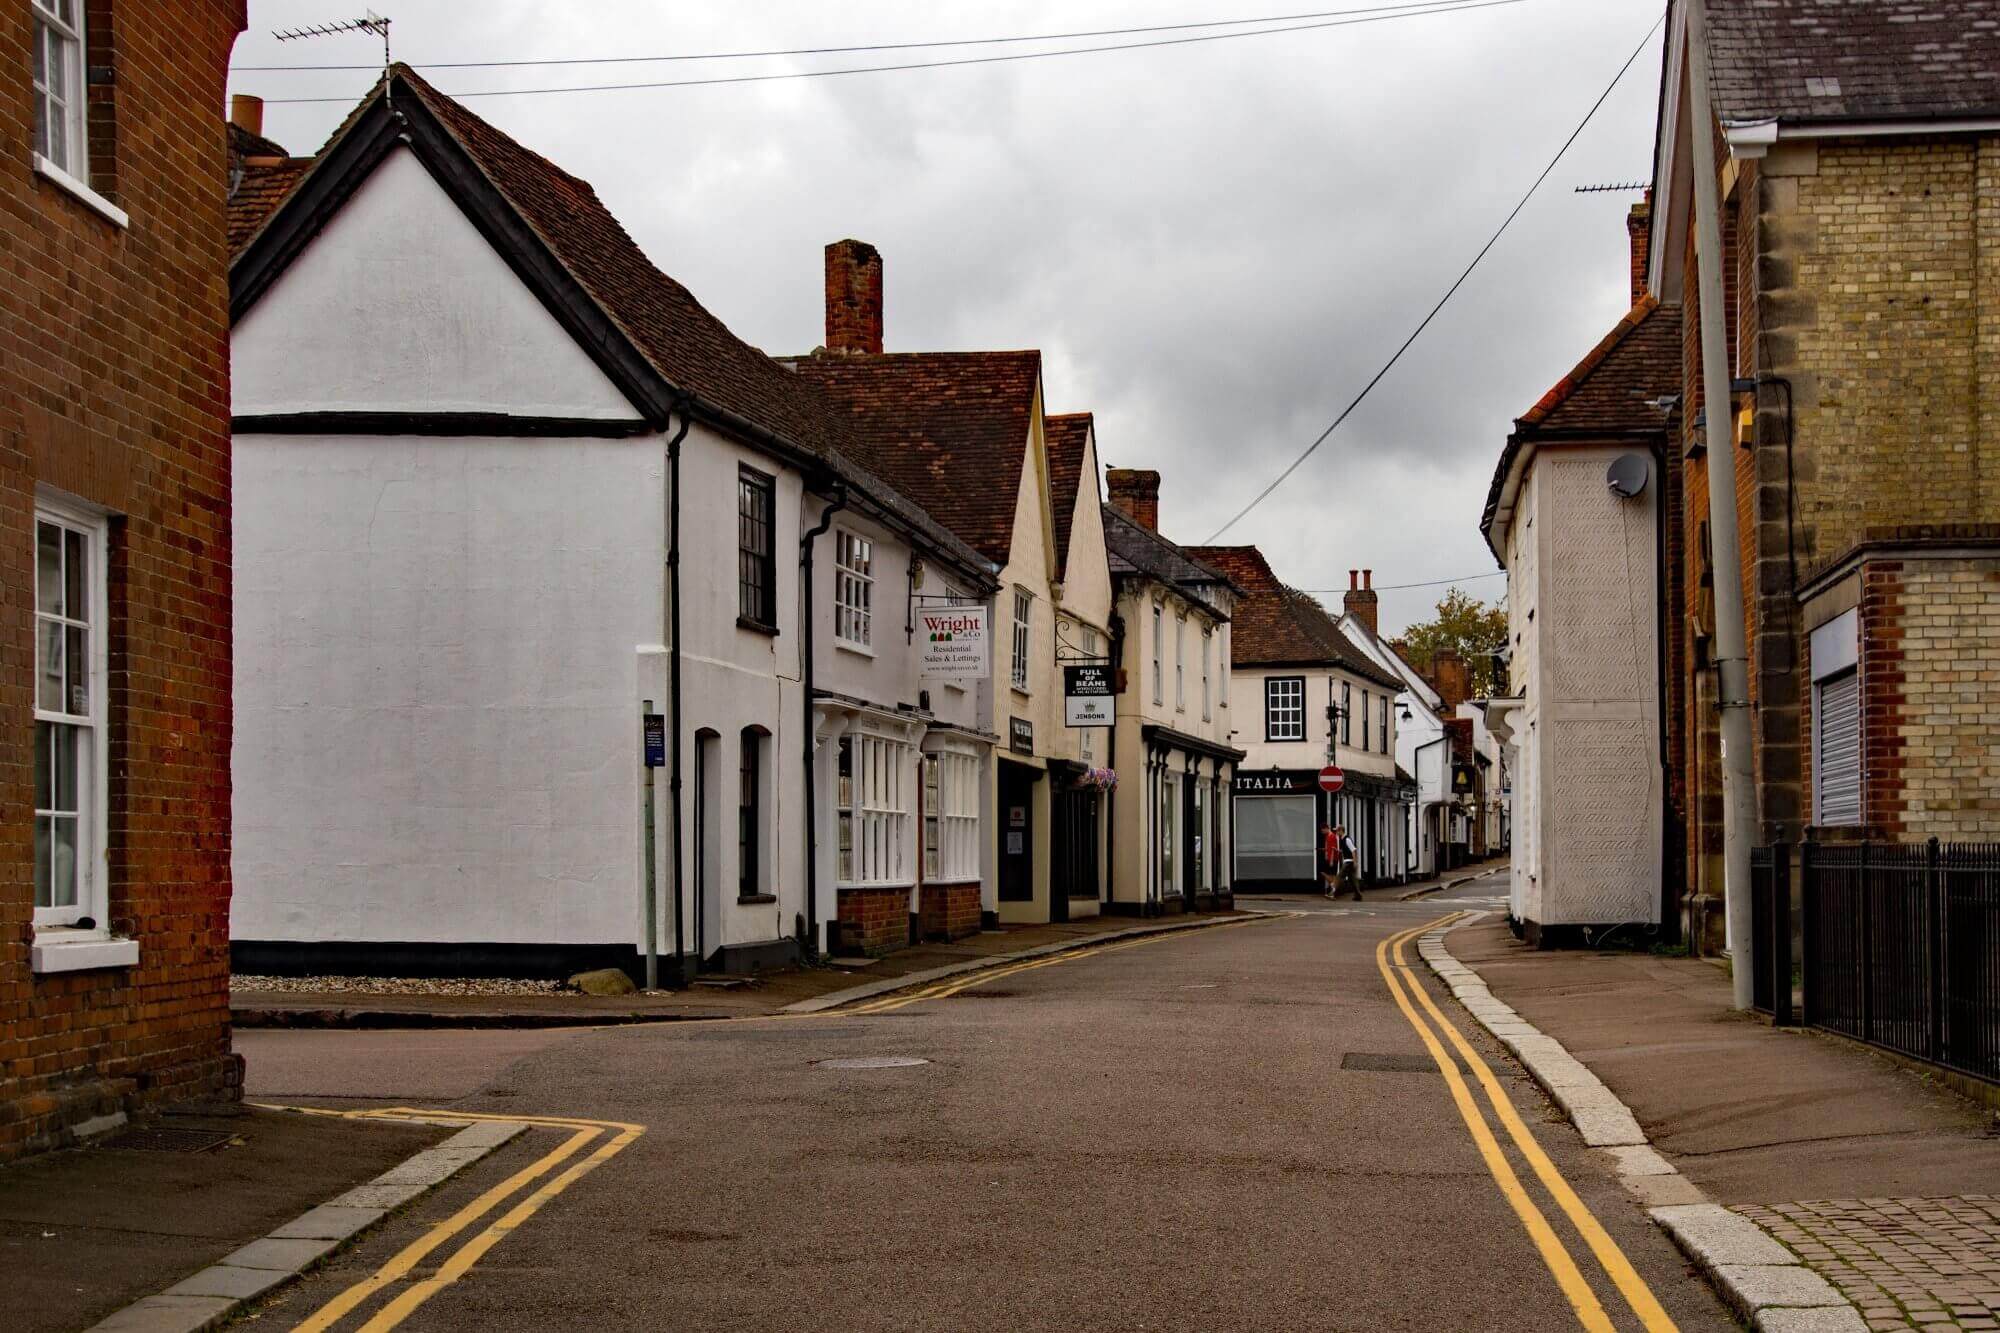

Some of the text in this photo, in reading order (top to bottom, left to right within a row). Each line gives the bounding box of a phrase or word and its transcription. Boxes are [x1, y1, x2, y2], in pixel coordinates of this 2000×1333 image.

[924, 616, 980, 634] Wright
[944, 654, 950, 662] &
[953, 654, 981, 662] Lettings
[1236, 778, 1293, 789] ITALIA
